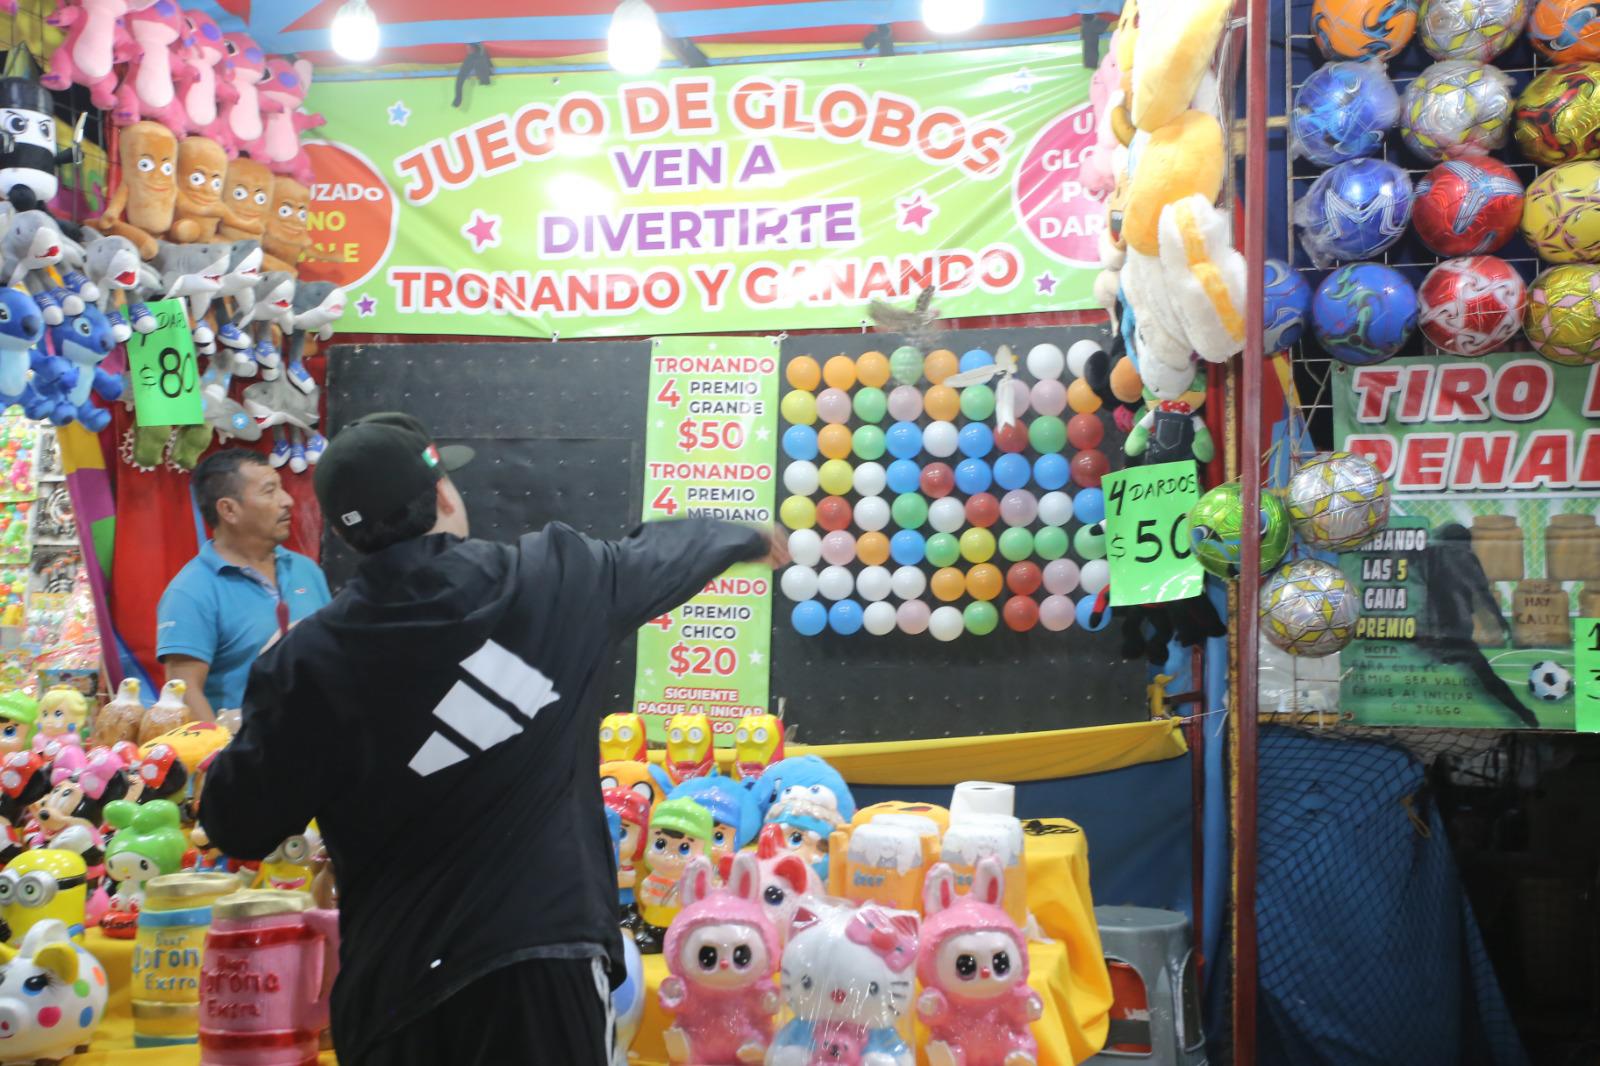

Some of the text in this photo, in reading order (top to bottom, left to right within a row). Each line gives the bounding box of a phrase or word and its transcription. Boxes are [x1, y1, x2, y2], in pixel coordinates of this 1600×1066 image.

[400, 81, 1009, 201] JUEGO DE GLOBOS
[613, 143, 777, 189] VEN A
[306, 211, 346, 231] NO
[543, 201, 855, 254] DIVERTIRTE
[393, 271, 681, 314] TRONANDO
[695, 269, 729, 306] Y
[653, 357, 776, 374] TRONANDO
[657, 379, 759, 408] 4 PREMIO
[1354, 360, 1553, 421] TIRO
[689, 401, 763, 415] GRANDE
[678, 417, 745, 453] $50
[649, 463, 772, 480] TRONANDO
[652, 486, 755, 516] 4 PREMIO
[1108, 473, 1196, 517] 4 DARDOS
[687, 508, 769, 521] MEDIANO
[1110, 513, 1192, 563] $50
[1361, 529, 1427, 551] BANDO
[1362, 558, 1409, 580] LAS 5
[702, 579, 768, 595] ANDO
[1363, 588, 1408, 609] GANA
[682, 605, 751, 620] PREMIO
[681, 625, 736, 639] CHICO
[1356, 616, 1417, 639] PREMIO
[669, 641, 737, 677] $20
[664, 687, 739, 702] SIGUIENTE
[637, 702, 764, 718] PAGUE AL INICIAR
